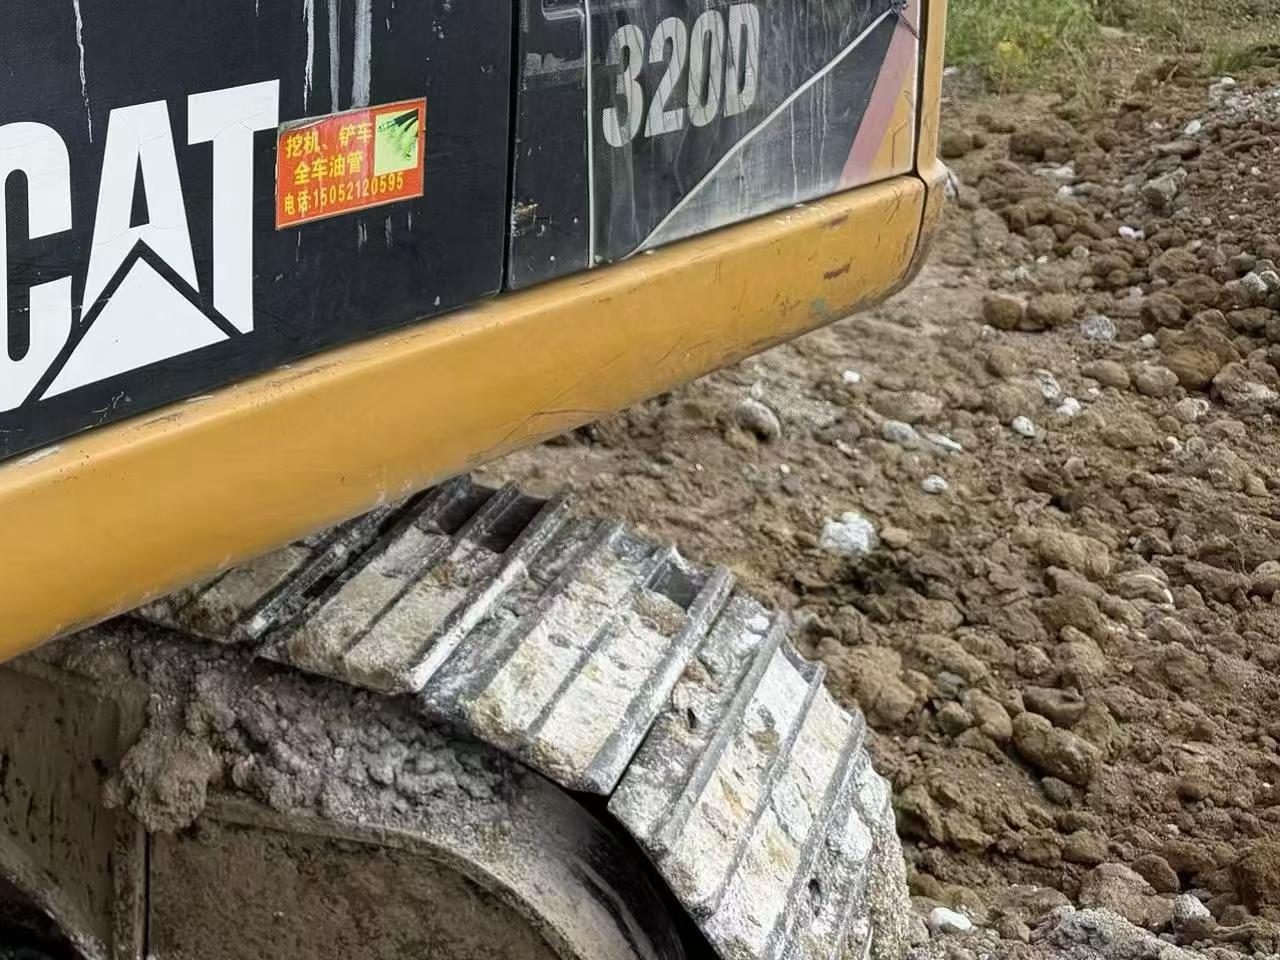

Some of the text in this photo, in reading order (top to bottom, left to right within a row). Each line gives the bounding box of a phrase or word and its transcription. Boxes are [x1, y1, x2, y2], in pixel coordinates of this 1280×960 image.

[602, 3, 760, 148] 320D
[293, 150, 364, 185] 全车油管
